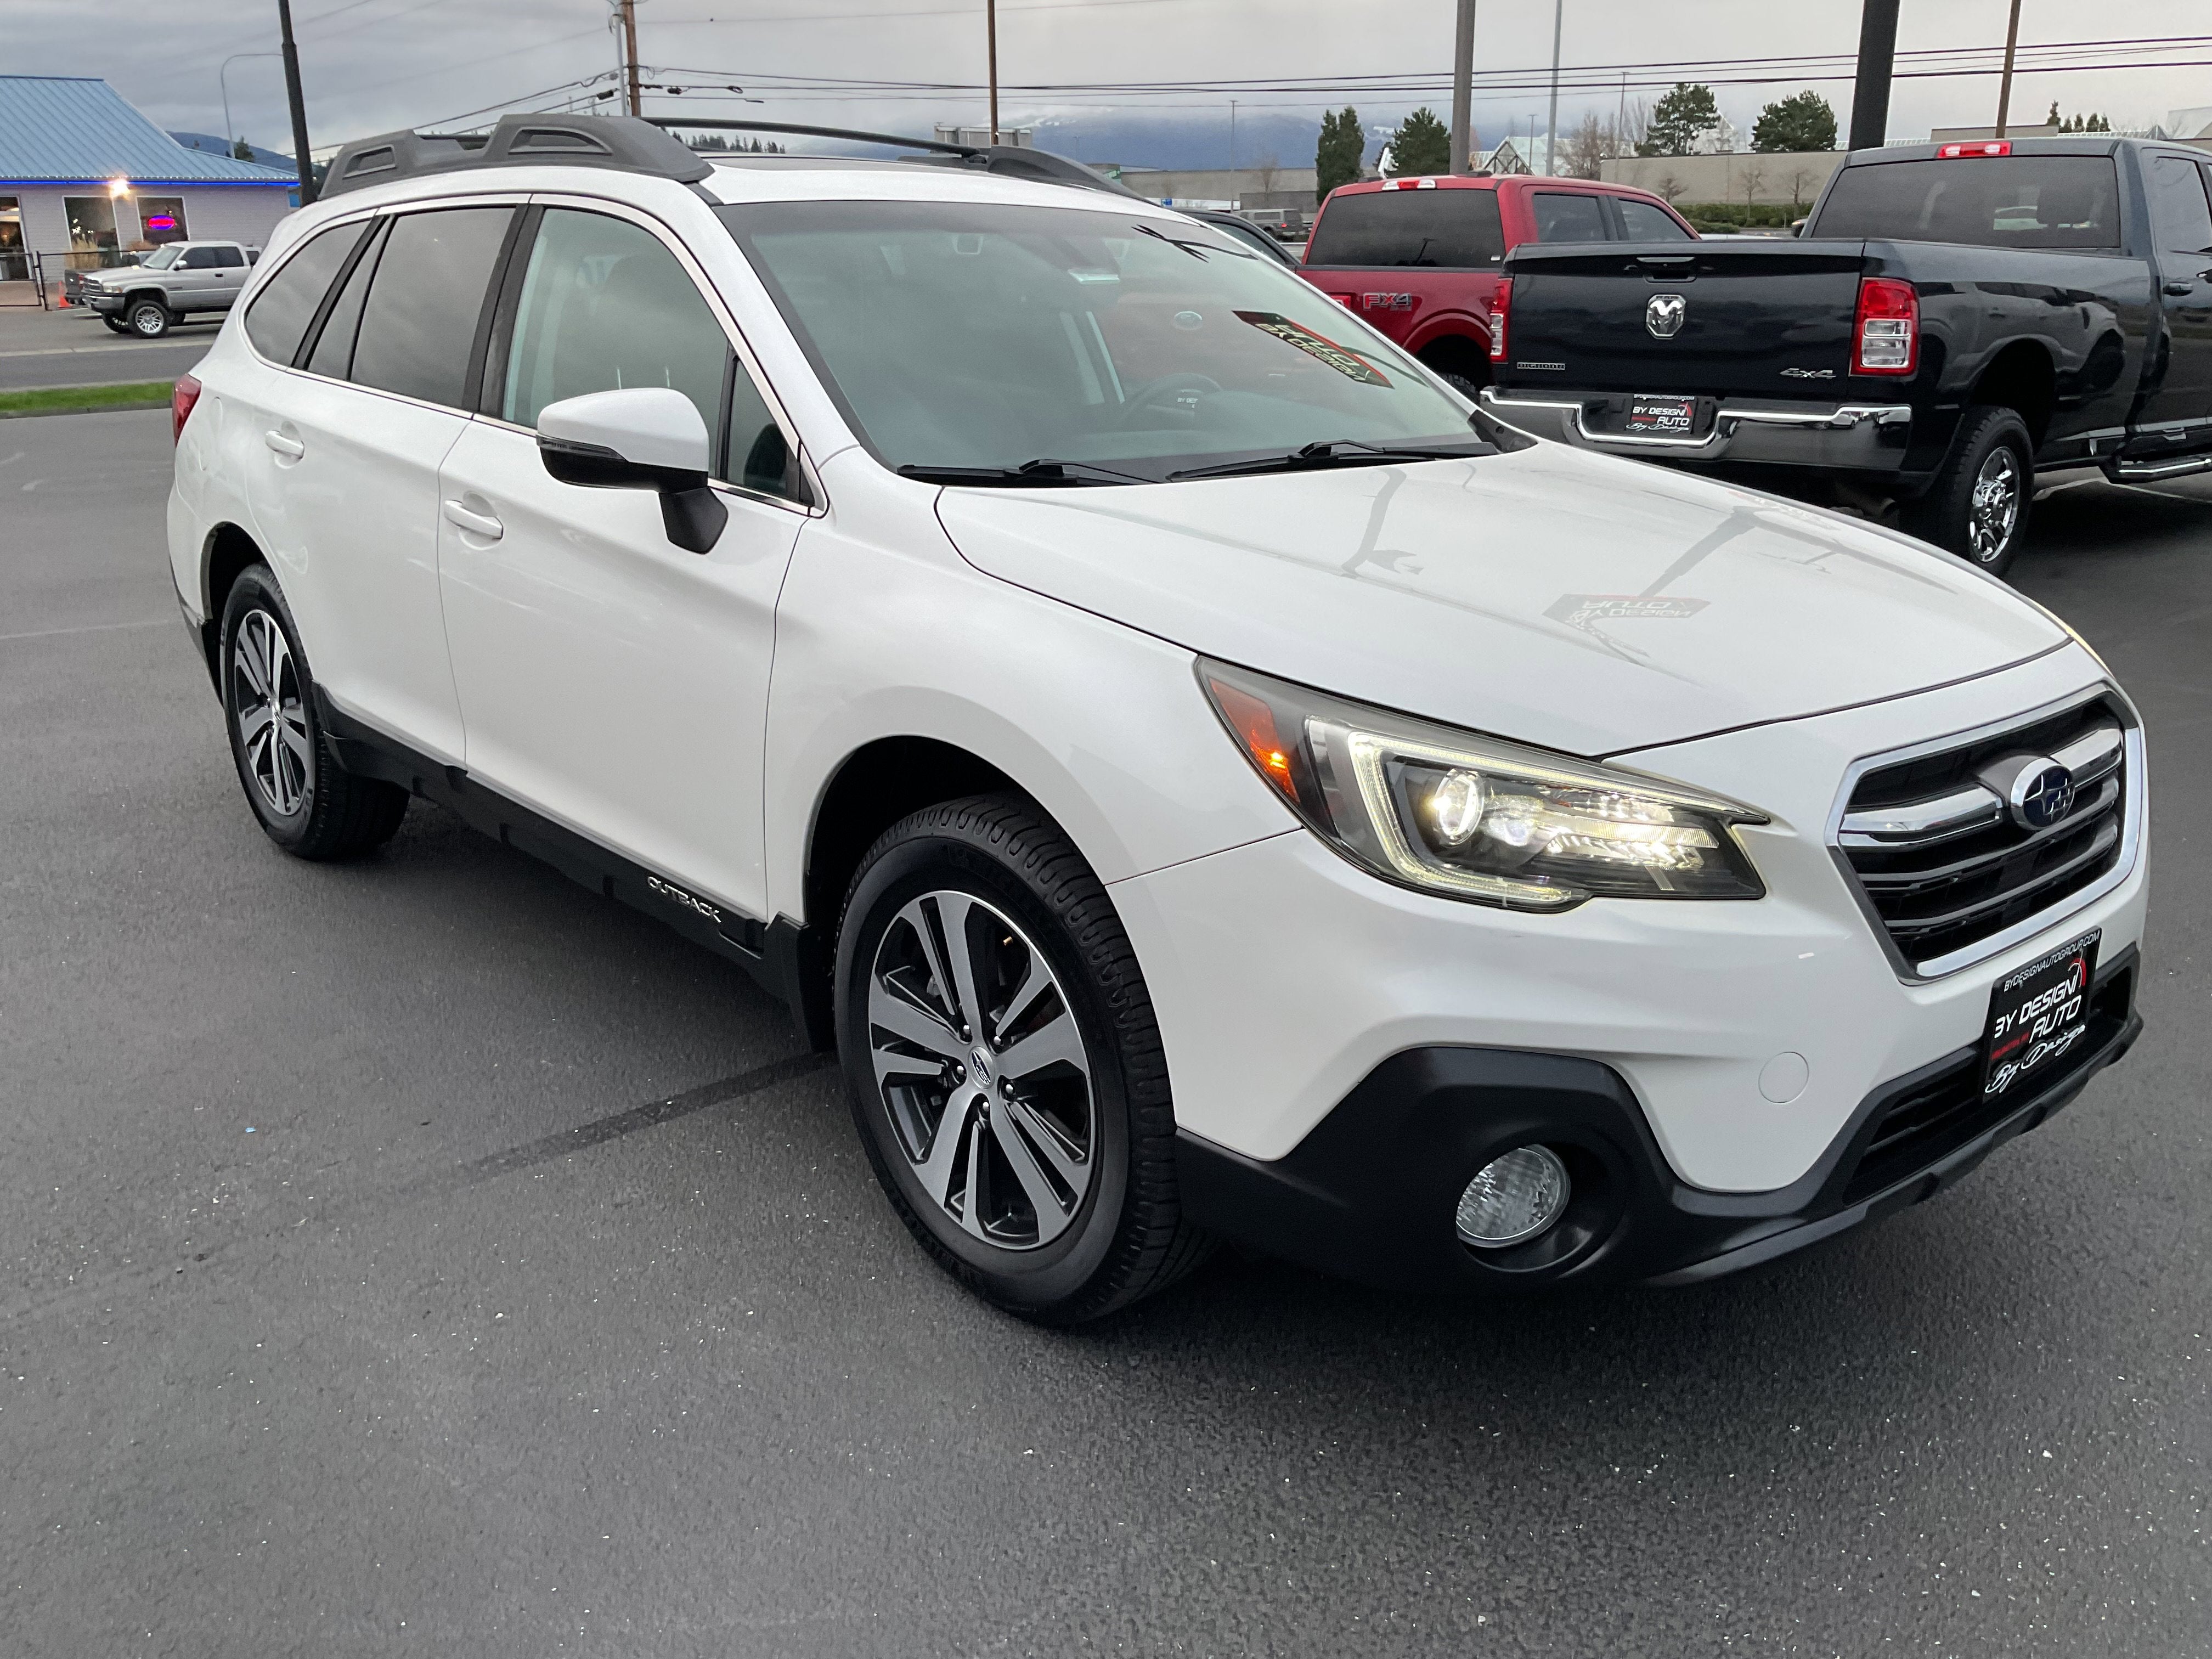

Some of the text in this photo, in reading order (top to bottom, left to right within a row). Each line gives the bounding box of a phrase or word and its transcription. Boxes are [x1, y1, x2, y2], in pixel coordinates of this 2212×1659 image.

[1362, 292, 1412, 309] FX4
[1626, 422, 1647, 432] By
[1649, 407, 1685, 416] DESIGN
[1656, 416, 1690, 426] AUTO
[647, 876, 721, 923] OUTBACK
[1994, 975, 2077, 1039] BY DESIGN
[2029, 995, 2081, 1043] AUTO
[1985, 1024, 2086, 1093] By Design
